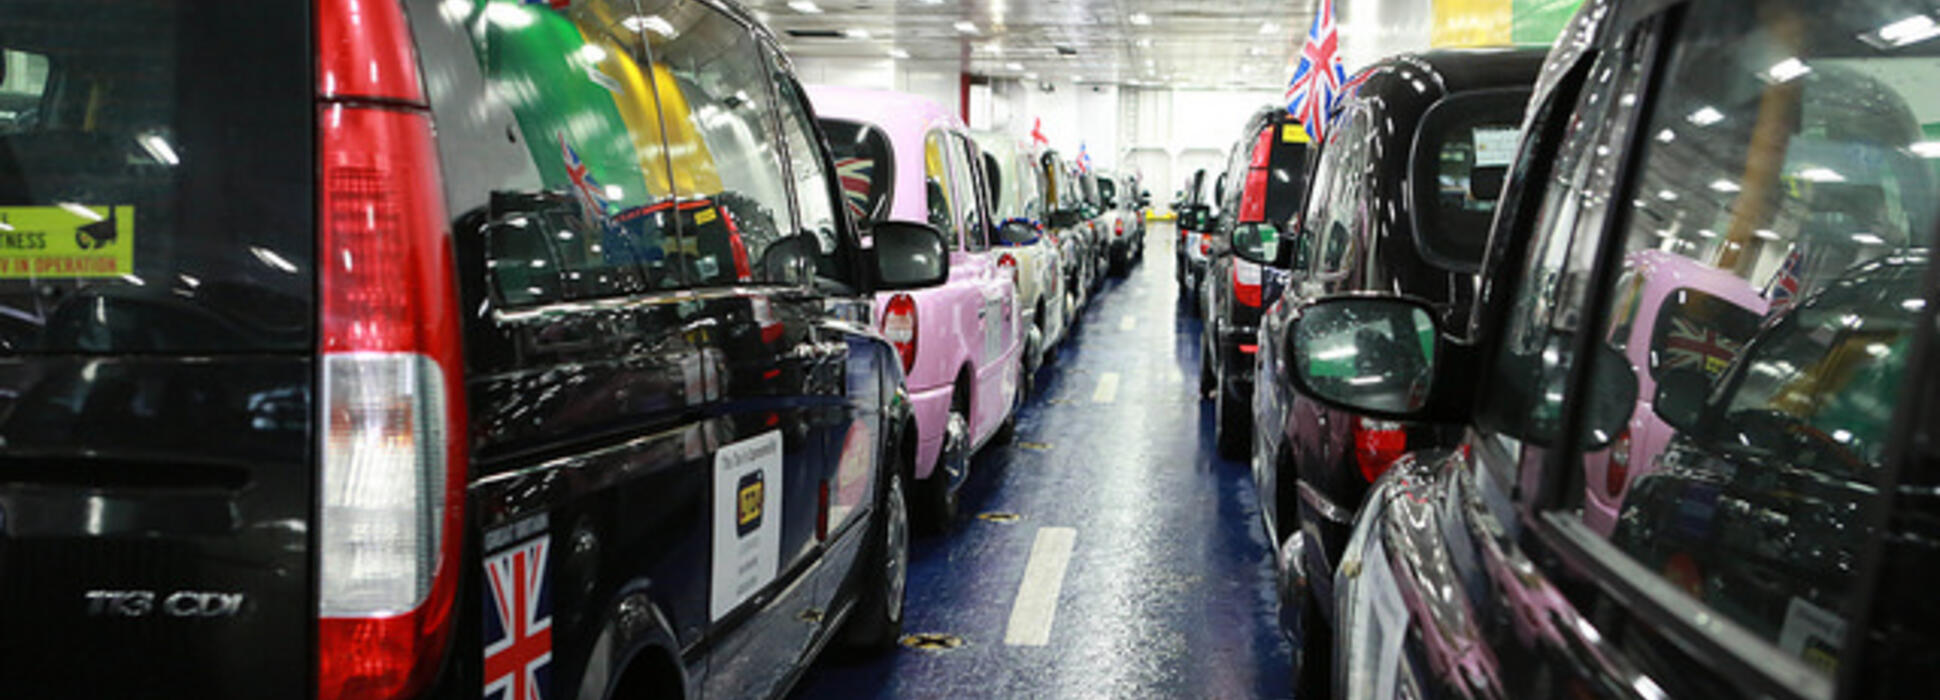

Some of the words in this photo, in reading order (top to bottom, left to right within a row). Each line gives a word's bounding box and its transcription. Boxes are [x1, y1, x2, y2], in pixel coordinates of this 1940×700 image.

[14, 257, 29, 273] IN
[35, 257, 117, 273] OPERATION
[164, 590, 244, 616] CDI
